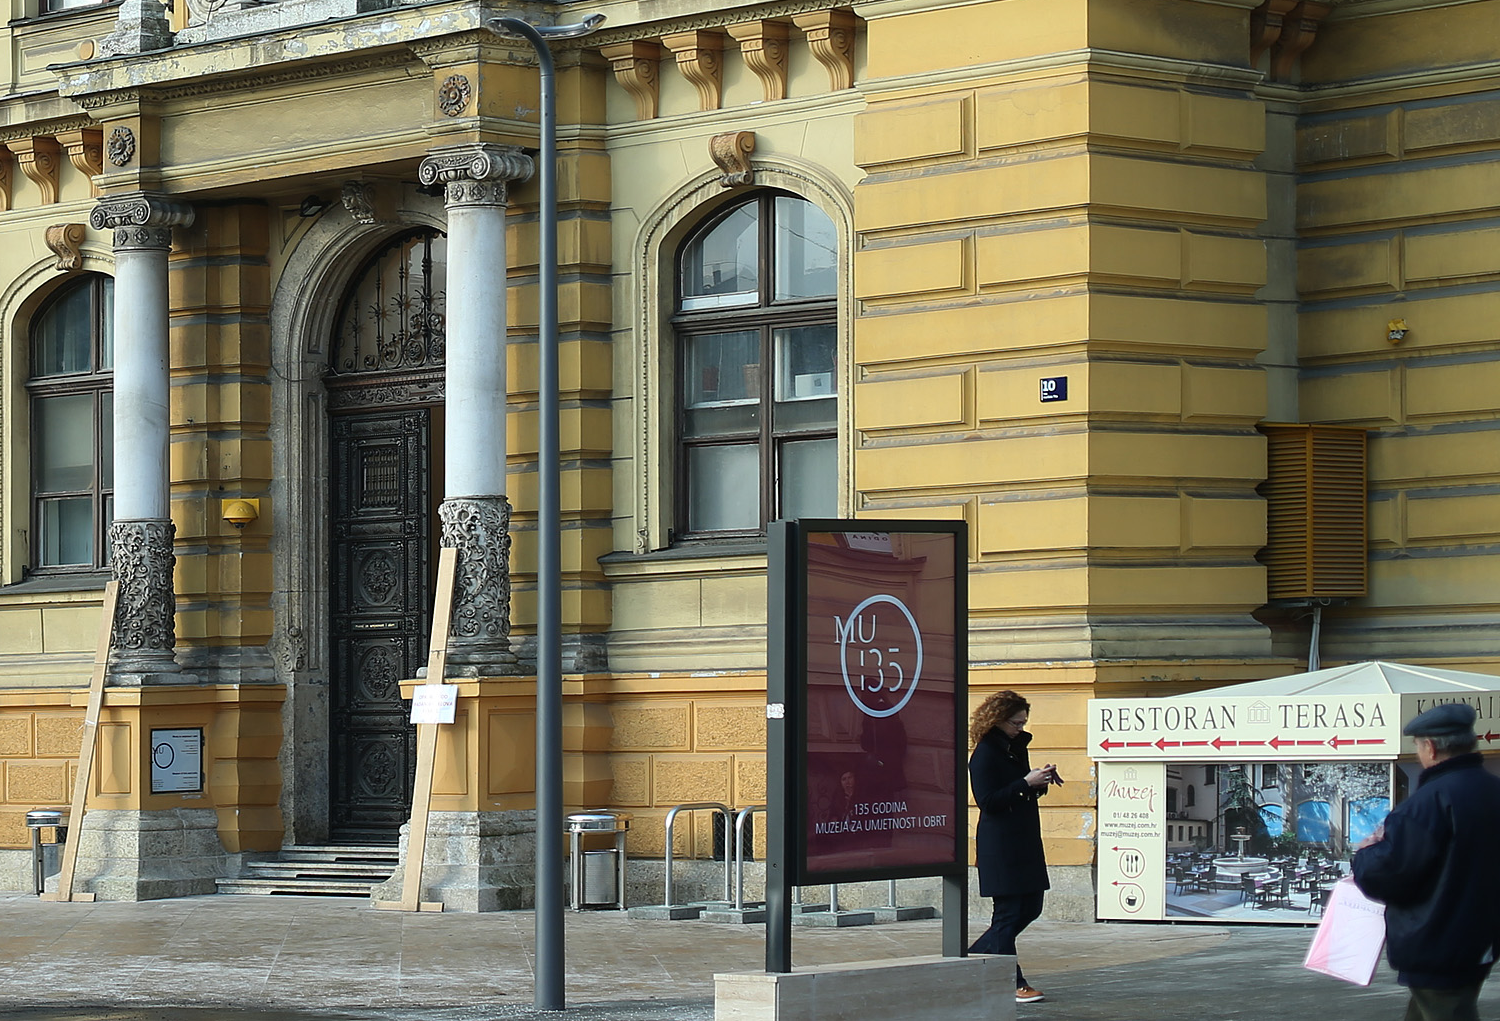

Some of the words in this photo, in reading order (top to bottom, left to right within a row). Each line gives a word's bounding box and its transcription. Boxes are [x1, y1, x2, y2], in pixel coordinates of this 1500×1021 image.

[1042, 380, 1056, 392] 10
[833, 614, 876, 644] MU
[1100, 705, 1237, 732] RESTORAN
[1278, 702, 1387, 729] TERASA
[854, 803, 869, 815] 135
[872, 801, 908, 814] GODINA
[1104, 780, 1157, 813] Muzej
[815, 820, 849, 834] MUZEJA
[850, 820, 862, 832] ZA
[865, 816, 917, 831] UMJETNOST
[923, 815, 947, 828] OBRT
